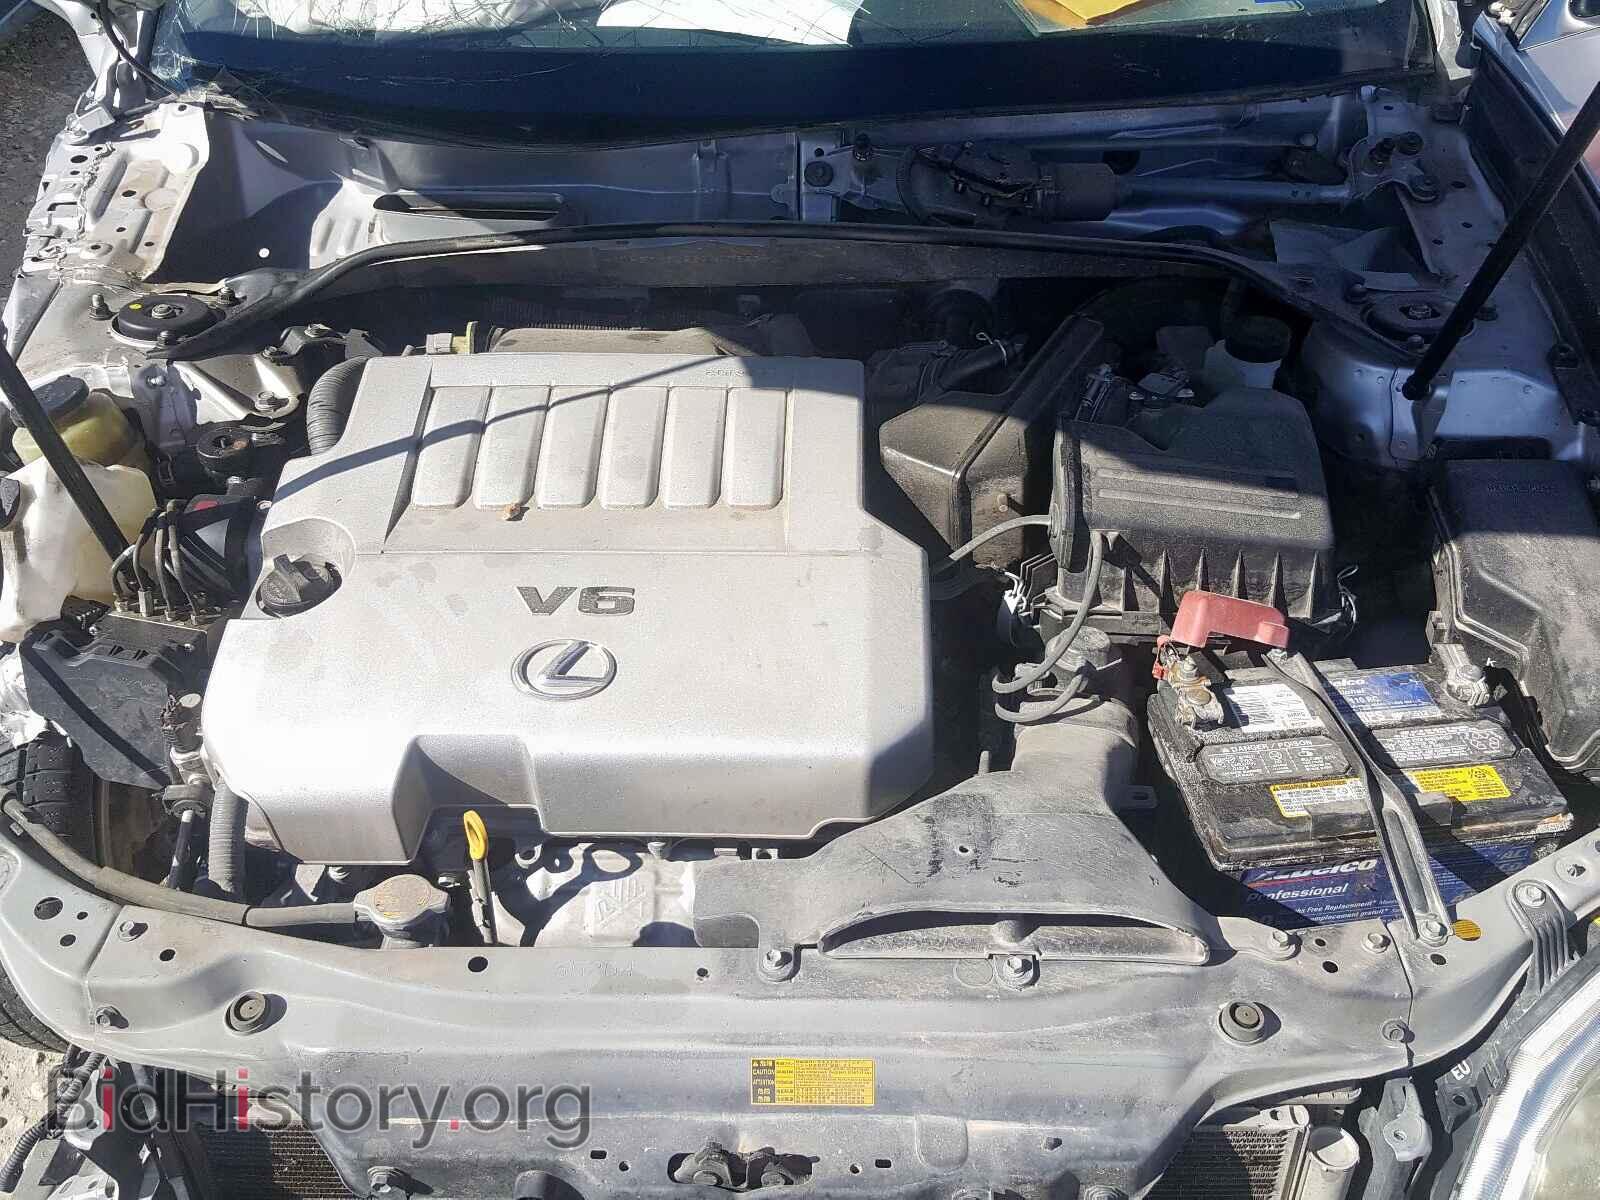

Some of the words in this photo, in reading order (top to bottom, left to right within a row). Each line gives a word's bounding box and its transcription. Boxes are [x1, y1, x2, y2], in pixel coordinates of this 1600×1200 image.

[516, 586, 635, 615] V6
[1231, 742, 1268, 753] DANGER
[1277, 739, 1313, 749] POISON
[1247, 883, 1350, 902] Professional
[1307, 906, 1324, 914] Free
